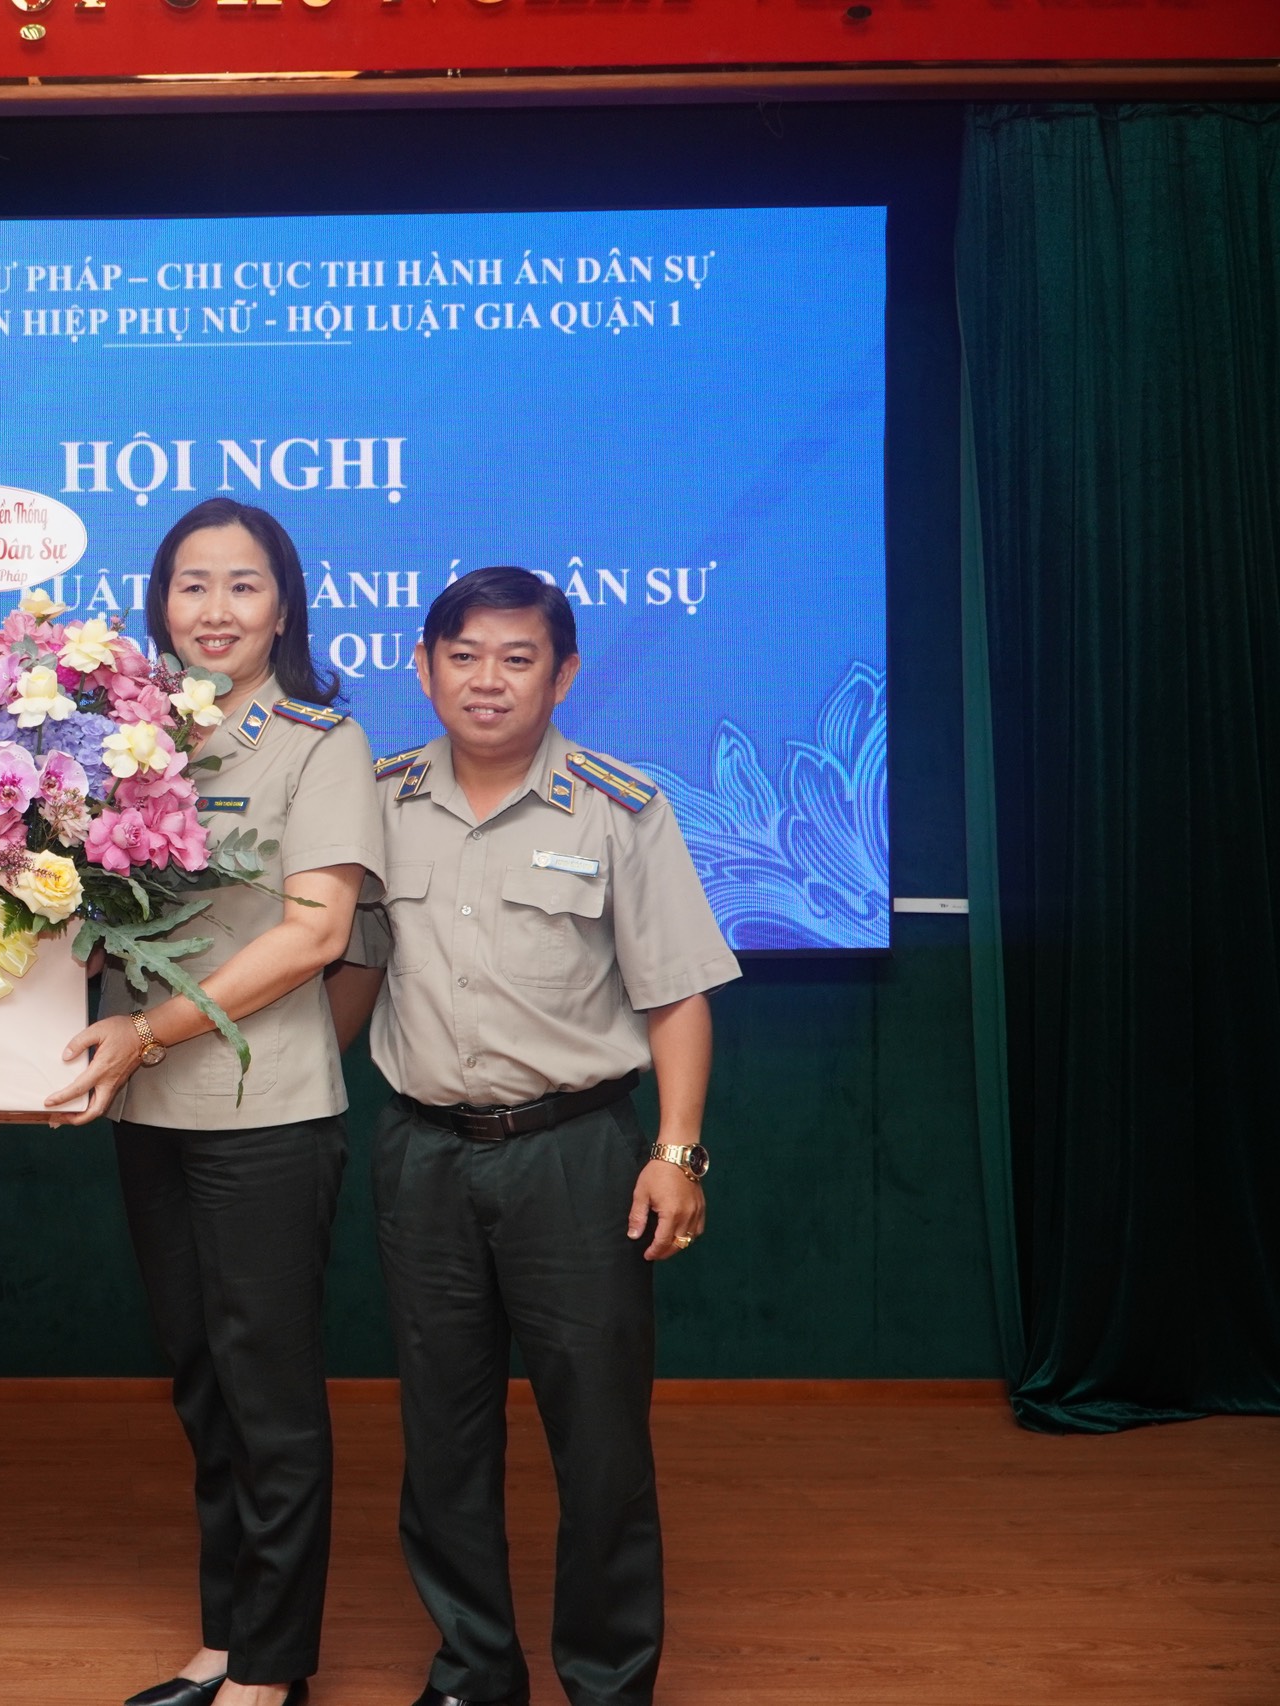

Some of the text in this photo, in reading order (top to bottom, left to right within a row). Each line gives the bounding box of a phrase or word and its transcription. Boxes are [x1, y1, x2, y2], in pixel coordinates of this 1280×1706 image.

[25, 256, 122, 293] PHÁP
[157, 262, 224, 290] CHI
[233, 261, 312, 297] CỤC
[320, 260, 384, 288] THI
[396, 251, 503, 287] HÀNH
[513, 250, 566, 285] ÁN
[576, 247, 654, 284] DÂN
[664, 250, 716, 291] SỰ
[22, 304, 109, 344] HIỆP
[117, 307, 190, 342] PHỤ
[202, 299, 258, 334] NỮ
[287, 301, 354, 340] HỘI
[366, 299, 466, 339] LUẬT
[474, 302, 543, 330] GIA
[550, 296, 656, 336] QUẬN
[669, 300, 682, 327] 1
[60, 431, 408, 507] HỘI NGHỊ
[14, 499, 48, 530] Thống
[40, 537, 68, 564] Sự
[0, 568, 29, 584] Pháp
[19, 568, 151, 622] UẬT
[304, 560, 421, 608] ÀNH
[646, 561, 717, 615] SỰ
